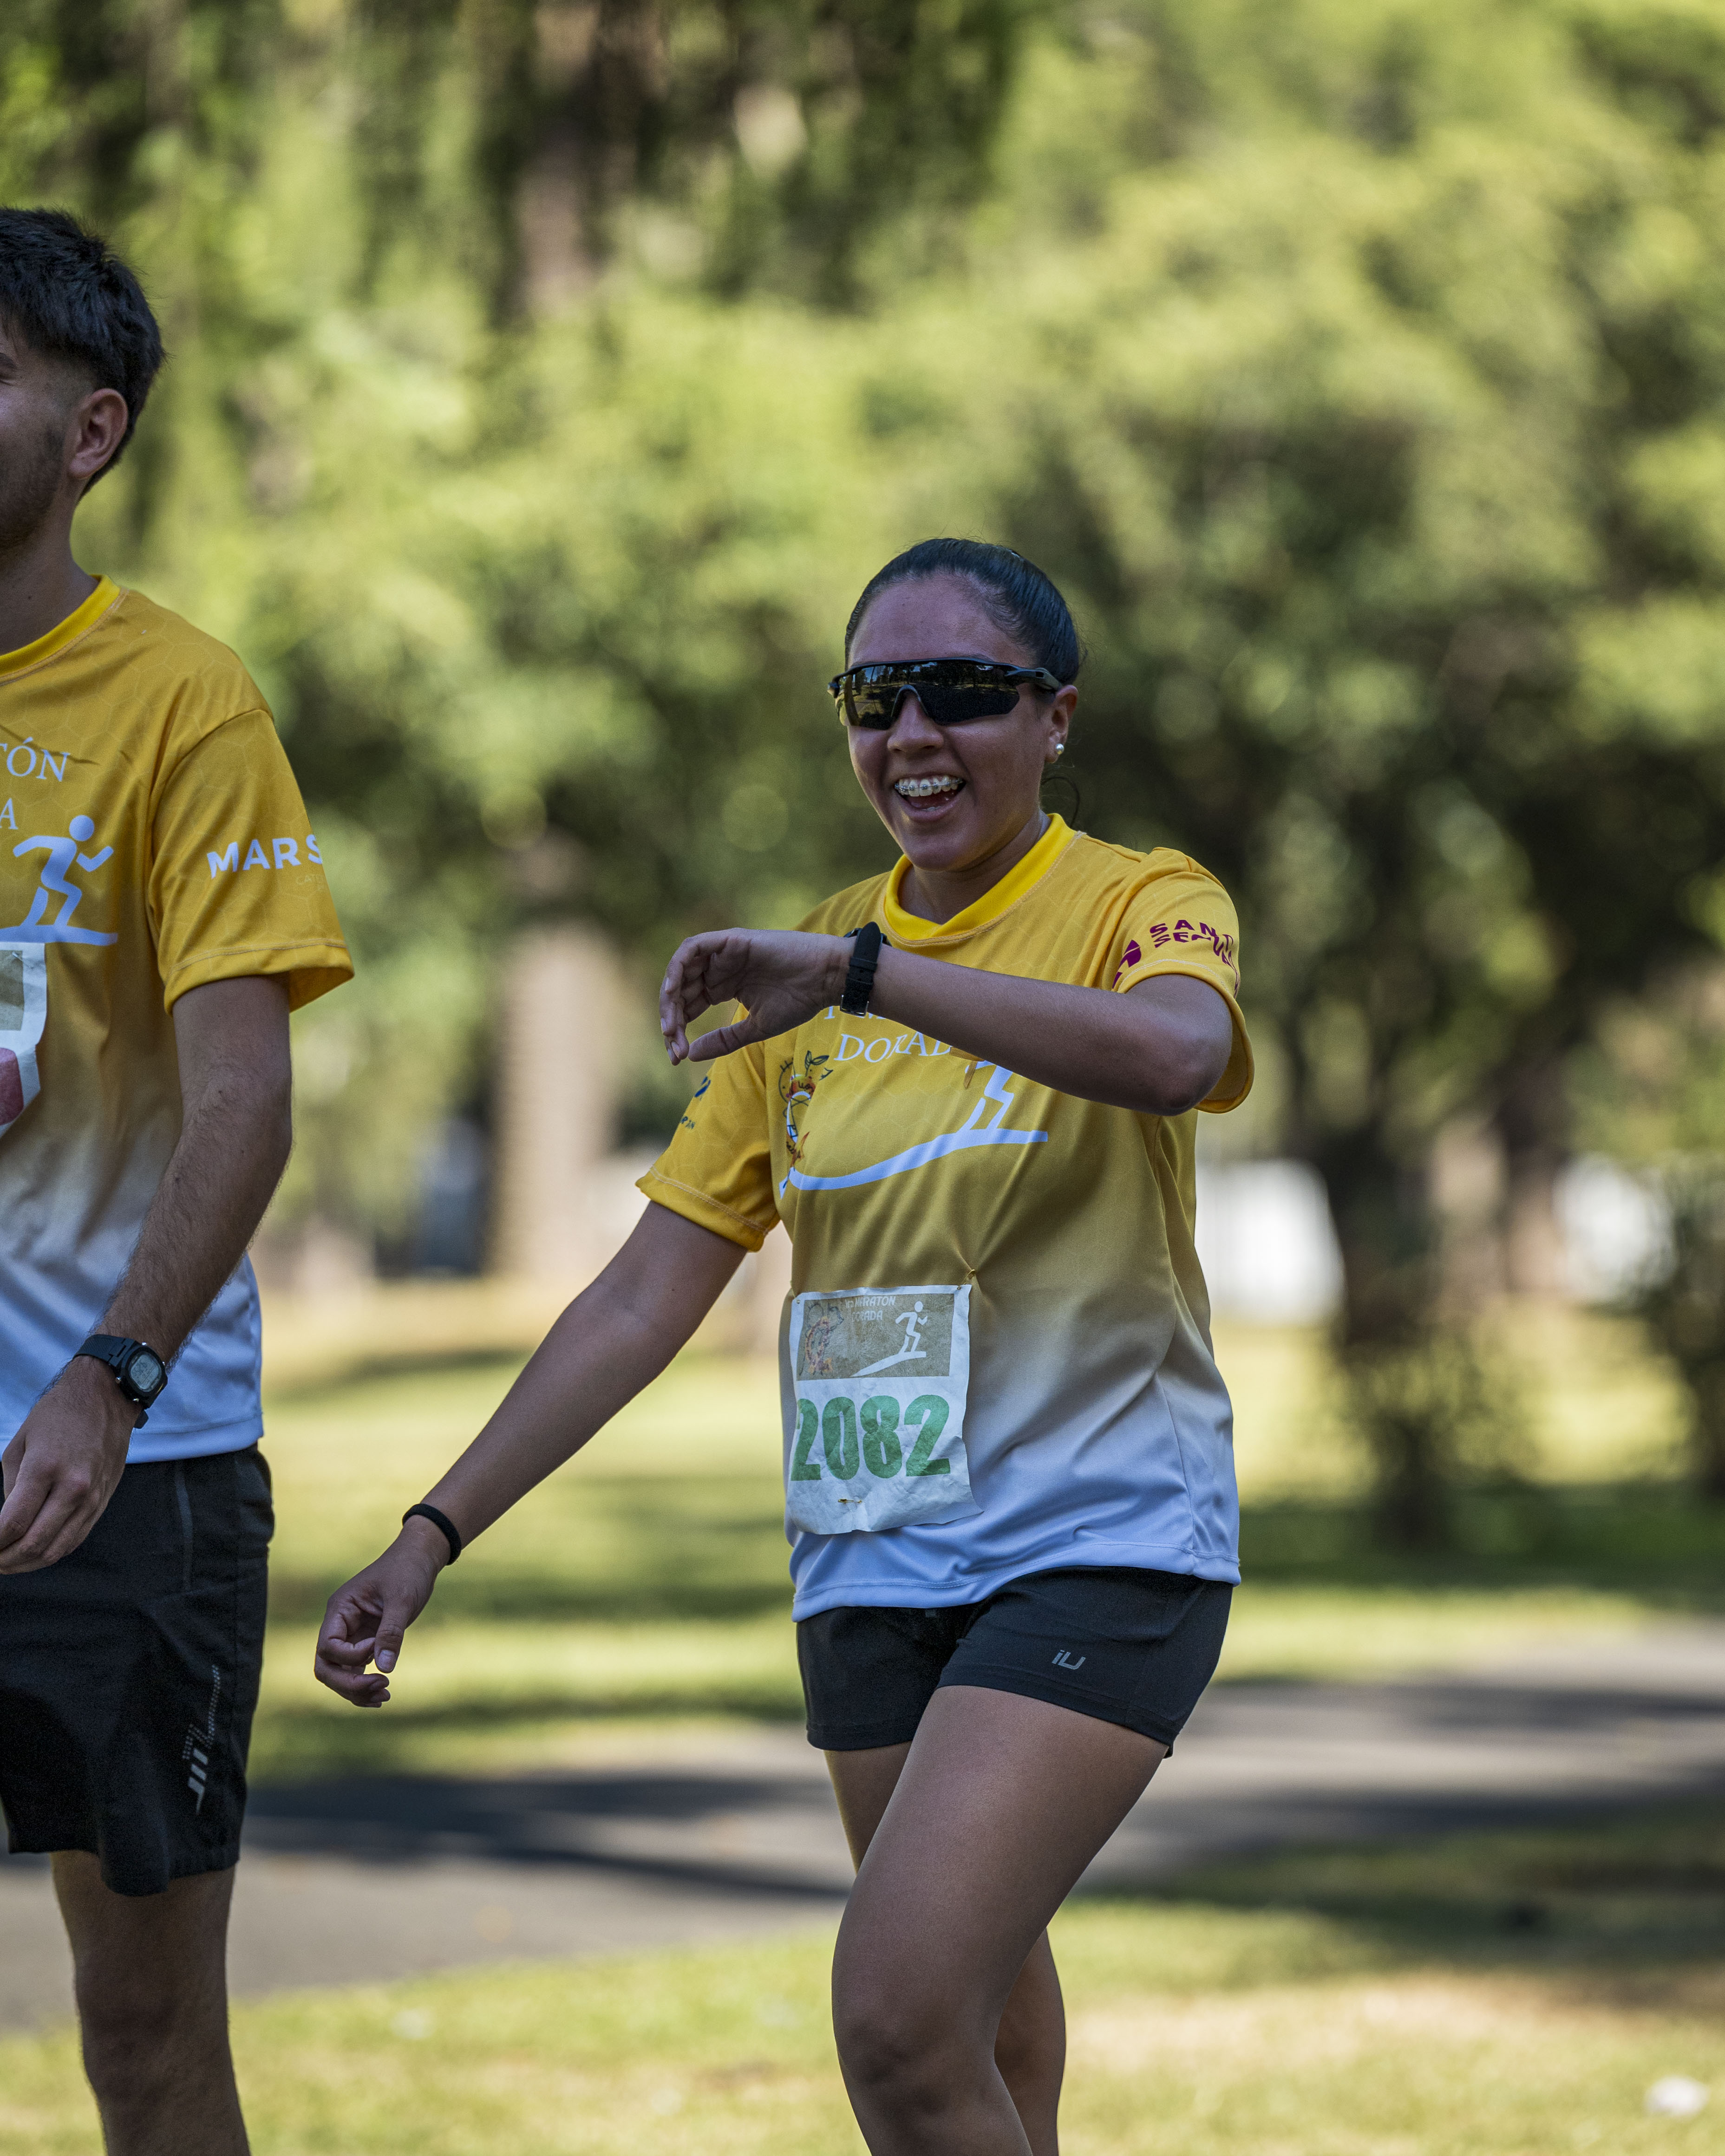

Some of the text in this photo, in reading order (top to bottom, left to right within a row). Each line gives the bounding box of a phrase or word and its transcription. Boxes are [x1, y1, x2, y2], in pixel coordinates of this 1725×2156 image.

[0, 736, 70, 782] ÓN
[207, 834, 323, 879] MARS
[791, 1394, 951, 1481] 2082
